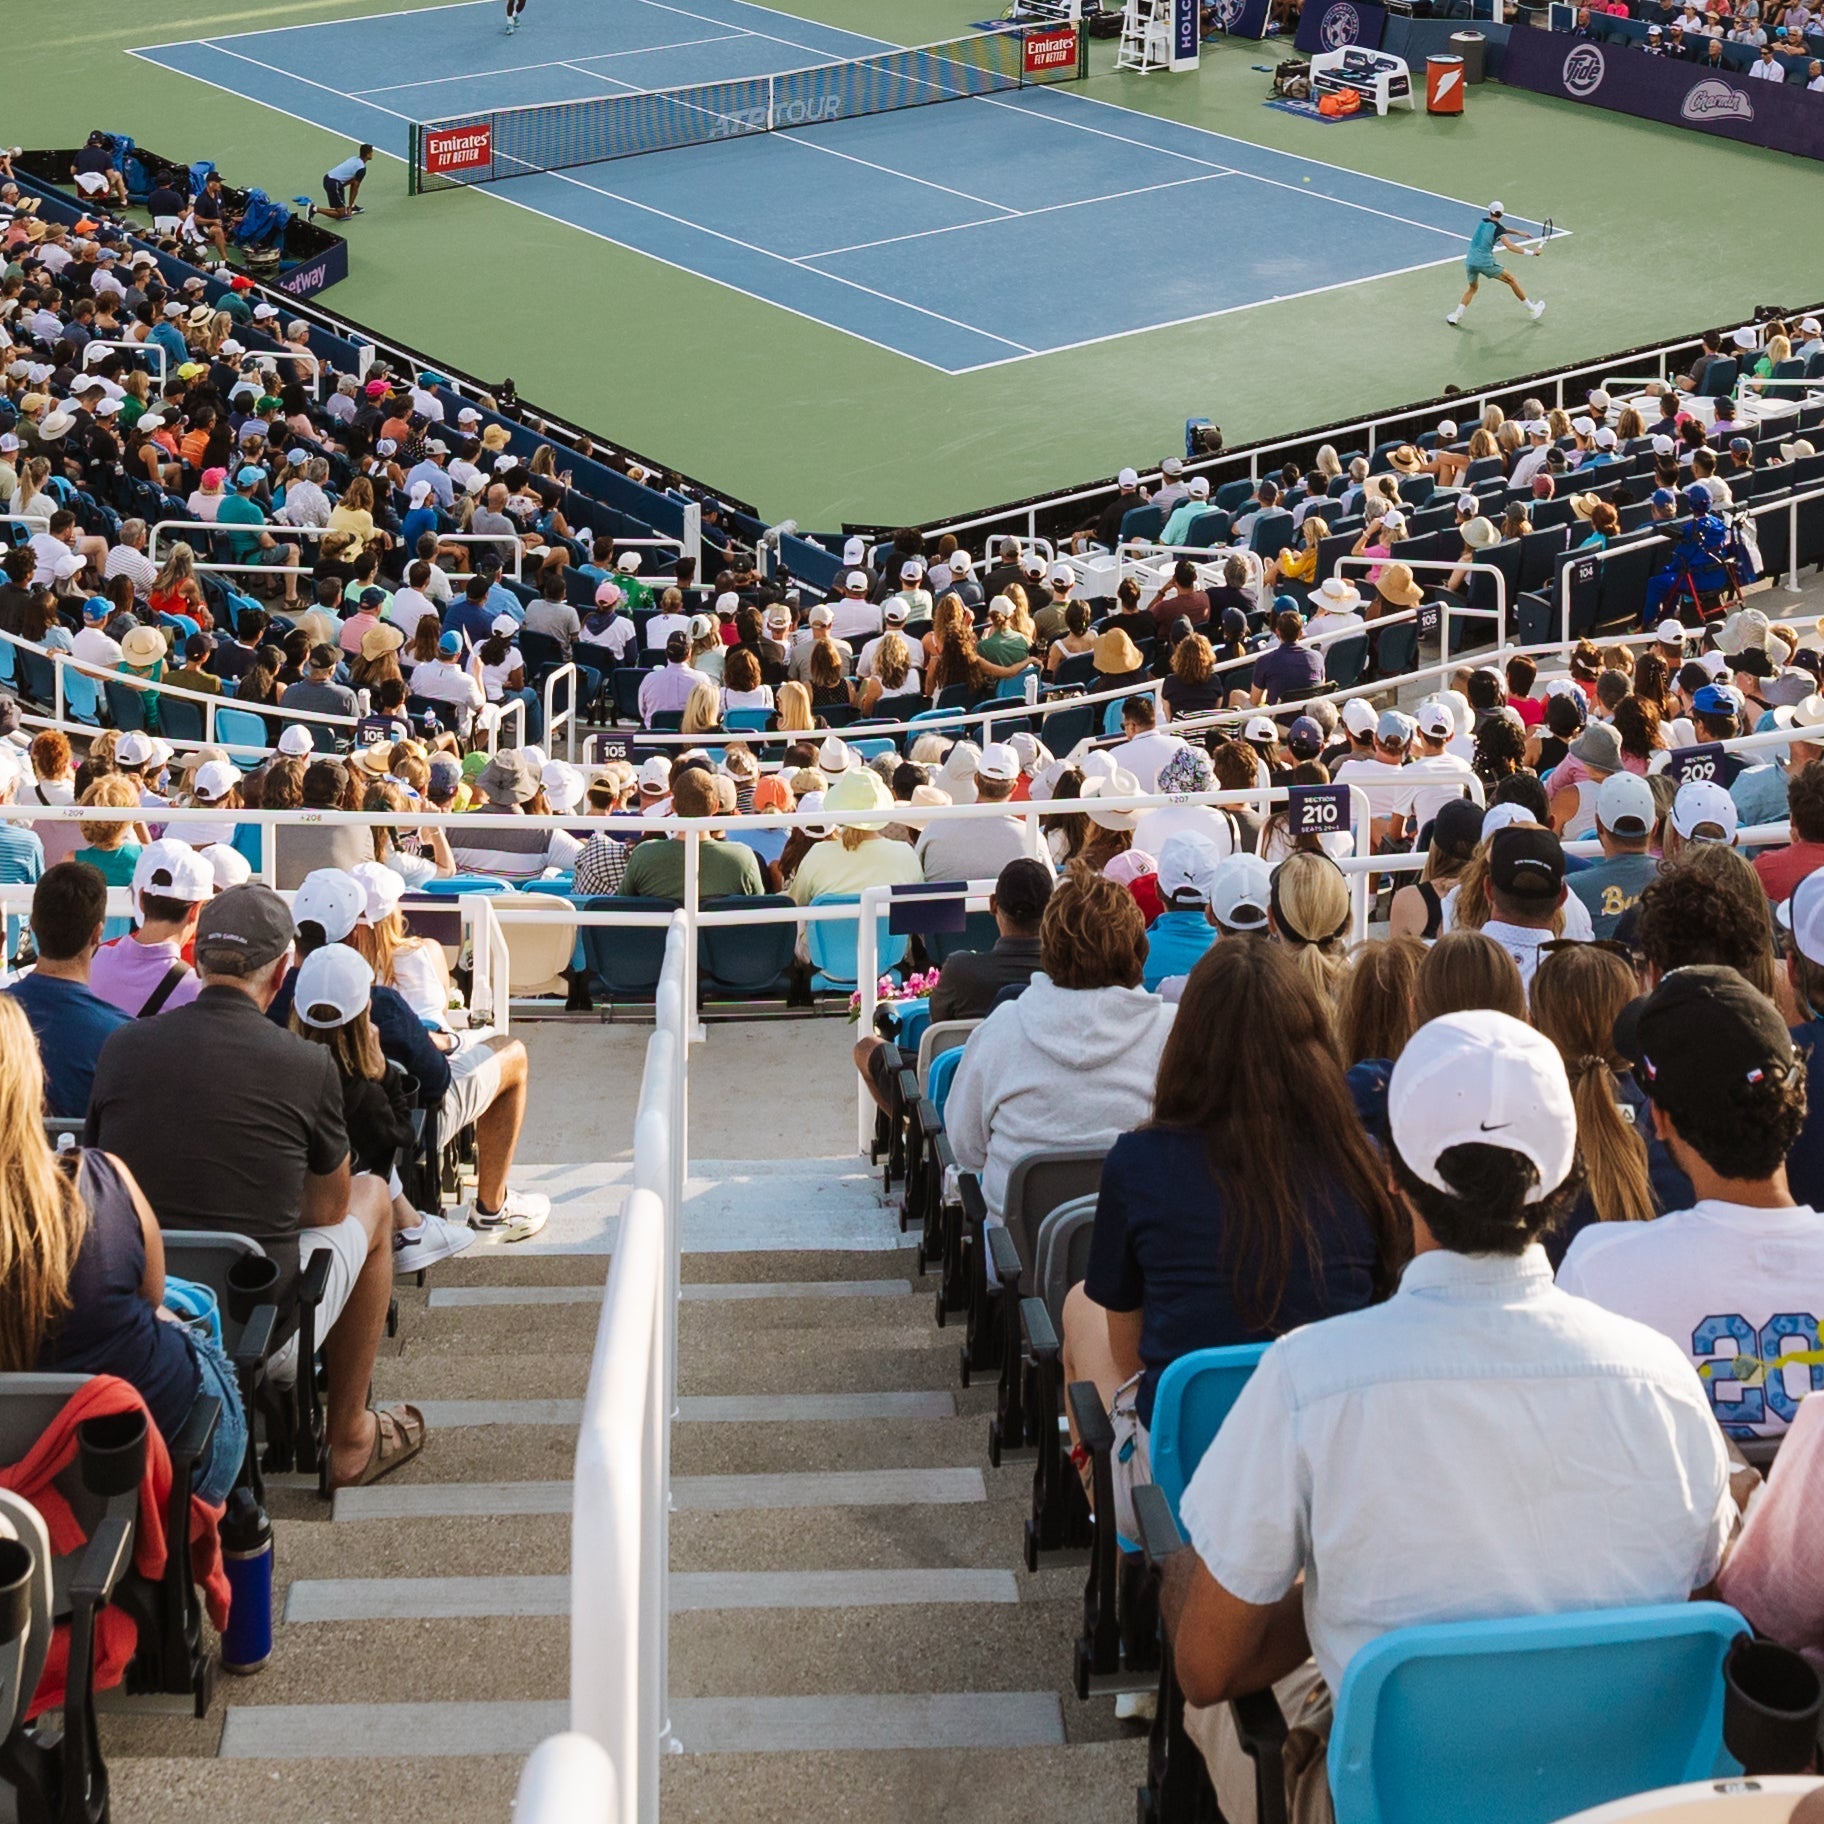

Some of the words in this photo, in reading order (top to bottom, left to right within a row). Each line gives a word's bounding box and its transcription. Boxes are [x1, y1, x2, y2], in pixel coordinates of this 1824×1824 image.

[1028, 37, 1075, 56] Emirates
[1034, 57, 1046, 65] FLY
[1046, 50, 1067, 63] BETTER
[1566, 54, 1602, 83] Tide
[1690, 89, 1741, 113] Charmin
[708, 105, 768, 138] ATP
[771, 96, 841, 125] TOUR
[429, 134, 489, 155] Emirates
[438, 152, 451, 166] FLY
[451, 148, 479, 164] BETTER
[1579, 566, 1594, 579] 104
[1422, 613, 1437, 627] 105
[362, 730, 385, 744] 105
[604, 746, 627, 758] 105
[1684, 754, 1712, 764] SECTION
[1680, 762, 1716, 785] 209
[1303, 795, 1337, 804] SECTION
[68, 809, 84, 817] 209
[1302, 803, 1337, 824] 210
